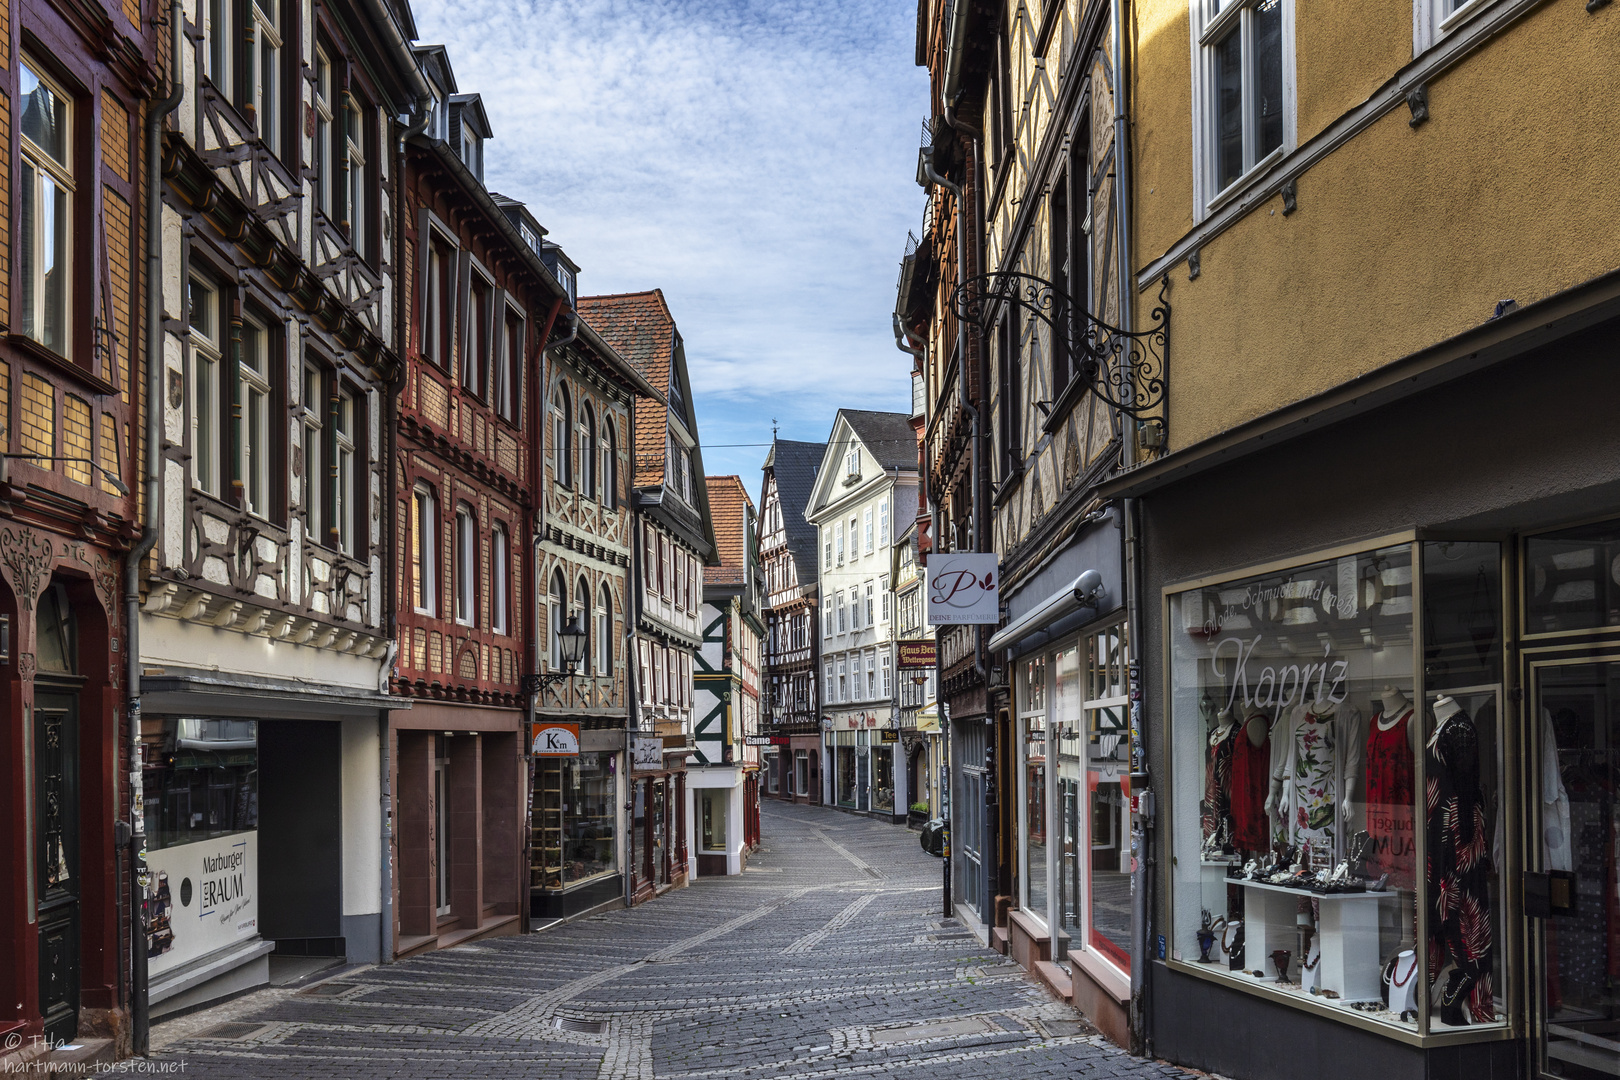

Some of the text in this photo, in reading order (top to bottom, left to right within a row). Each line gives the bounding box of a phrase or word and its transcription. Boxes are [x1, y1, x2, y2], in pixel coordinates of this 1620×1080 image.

[931, 568, 977, 604] P
[1242, 578, 1294, 609] Schmuck
[1298, 581, 1325, 602] und
[929, 612, 998, 622] DEINE PARFÜMERIE
[900, 645, 920, 657] Haus
[916, 677, 924, 685] 18
[1211, 634, 1349, 732] Kapriz
[745, 736, 790, 745] GameStop
[884, 731, 898, 739] Tee
[202, 851, 243, 874] Marburger
[209, 873, 243, 907] RAUM
